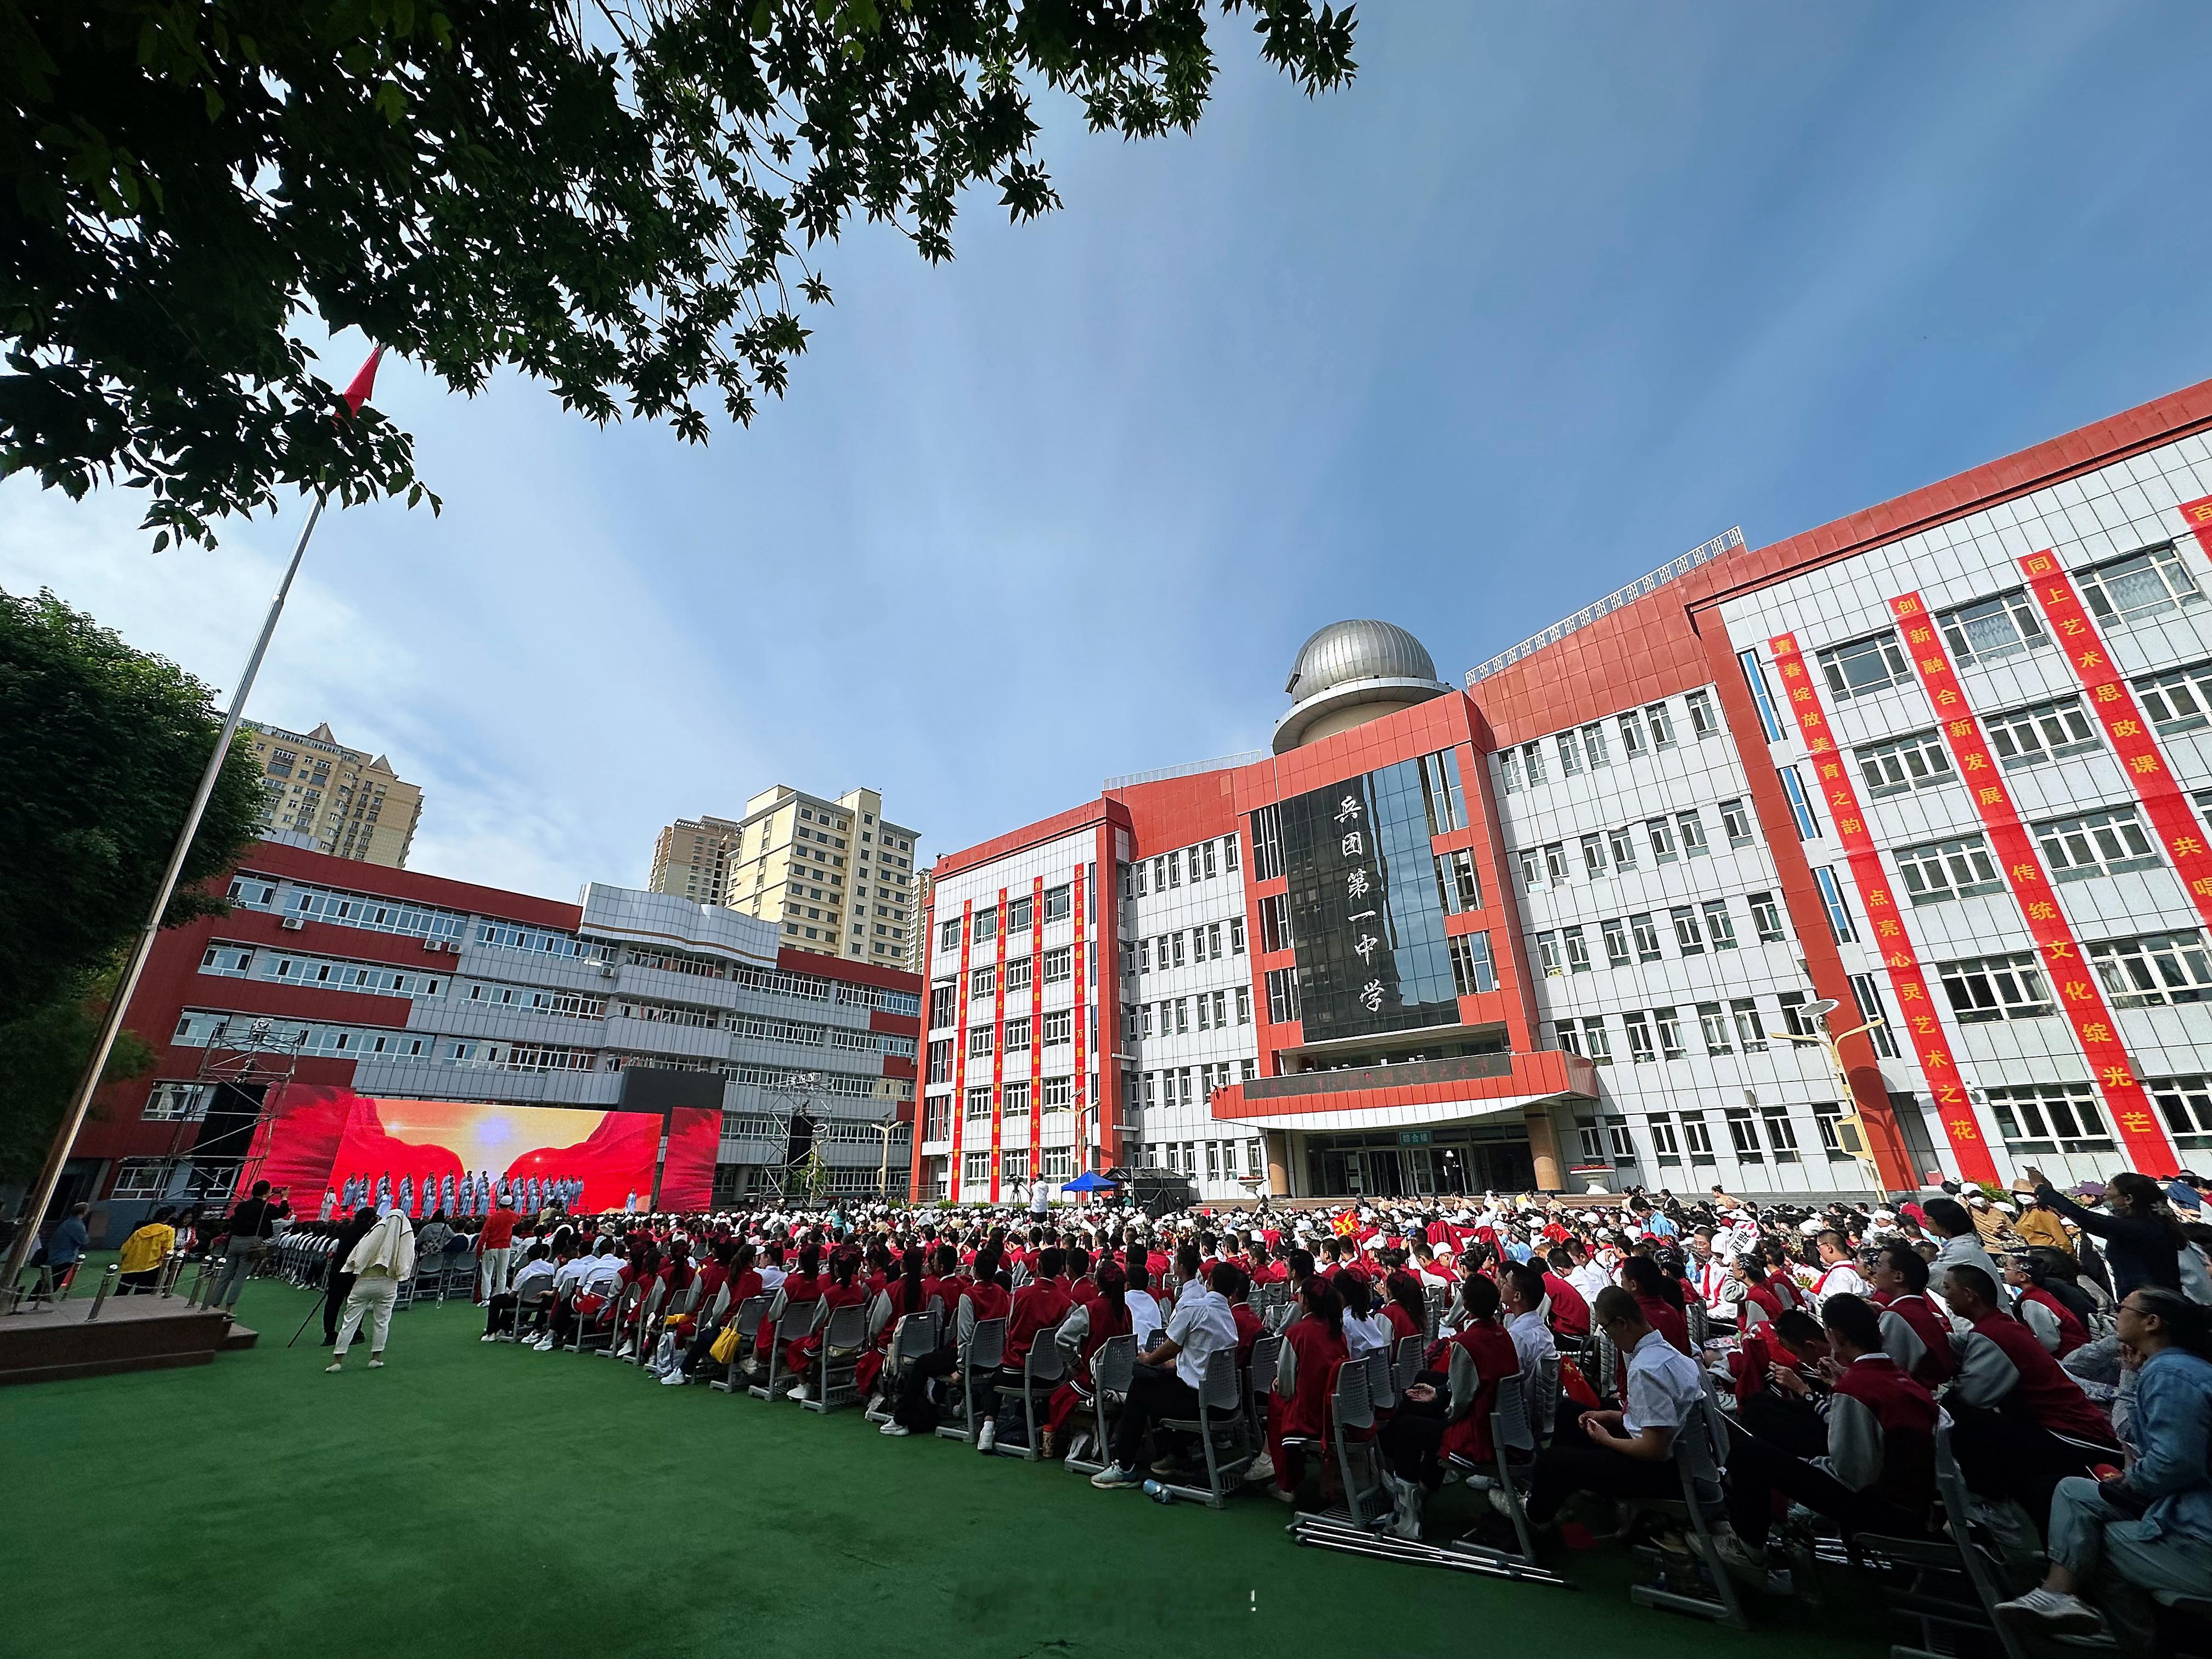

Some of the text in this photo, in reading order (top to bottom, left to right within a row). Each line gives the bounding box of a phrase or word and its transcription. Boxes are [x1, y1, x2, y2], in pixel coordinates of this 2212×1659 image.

[2027, 555, 2160, 774] 同上艺术思政课
[1334, 795, 1385, 1012] 兵团第一中学
[1774, 638, 1977, 1140] 青春绽放美育之韵 点亮心灵艺术之花
[1897, 596, 2152, 1133] 创新融合新发展 传统文化绽光芒
[1031, 1034, 1040, 1173] 胡杨精神代代传
